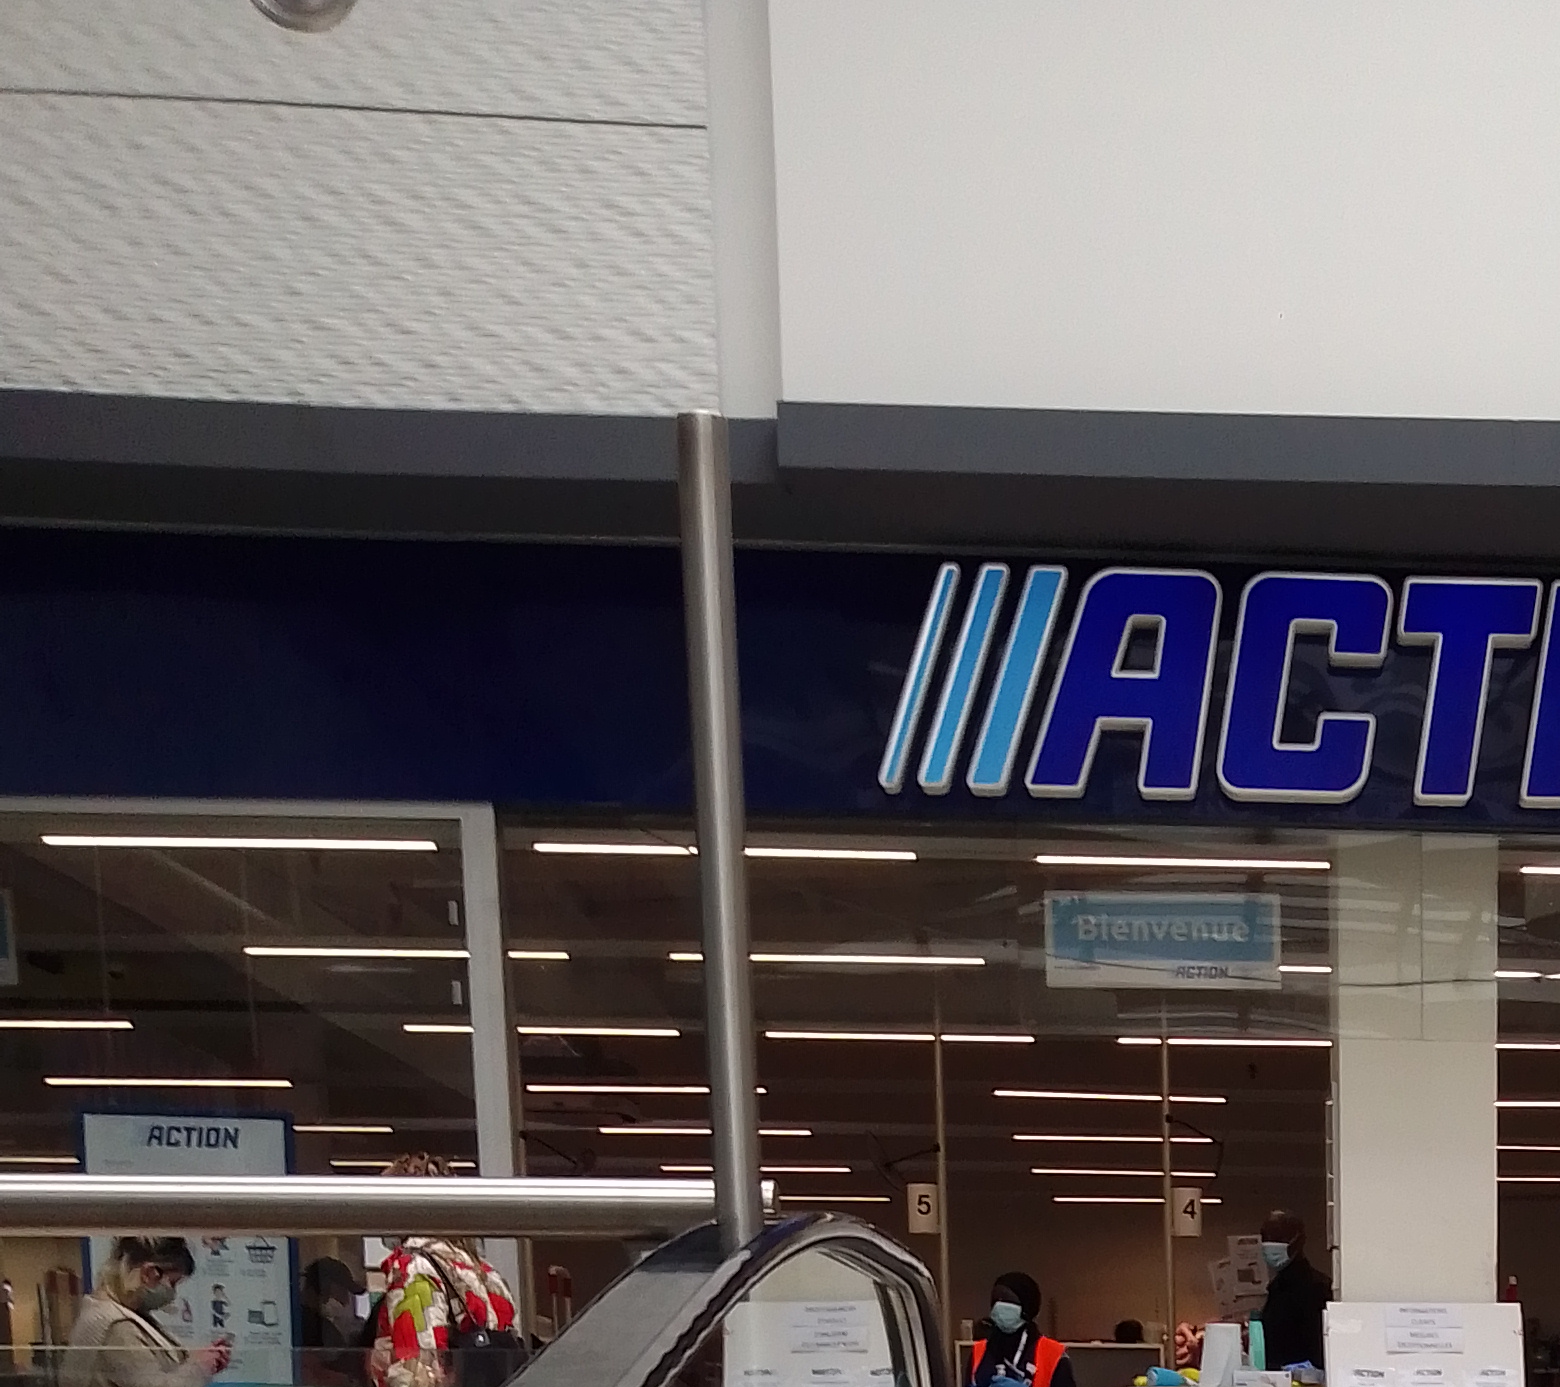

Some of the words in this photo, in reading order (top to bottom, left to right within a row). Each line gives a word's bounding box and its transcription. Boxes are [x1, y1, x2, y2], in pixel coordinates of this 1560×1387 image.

[1076, 914, 1250, 943] Bienvenue
[1175, 966, 1229, 980] ACTION
[147, 1125, 240, 1149] ACTION
[916, 1194, 931, 1216] 5
[1183, 1197, 1198, 1220] 4
